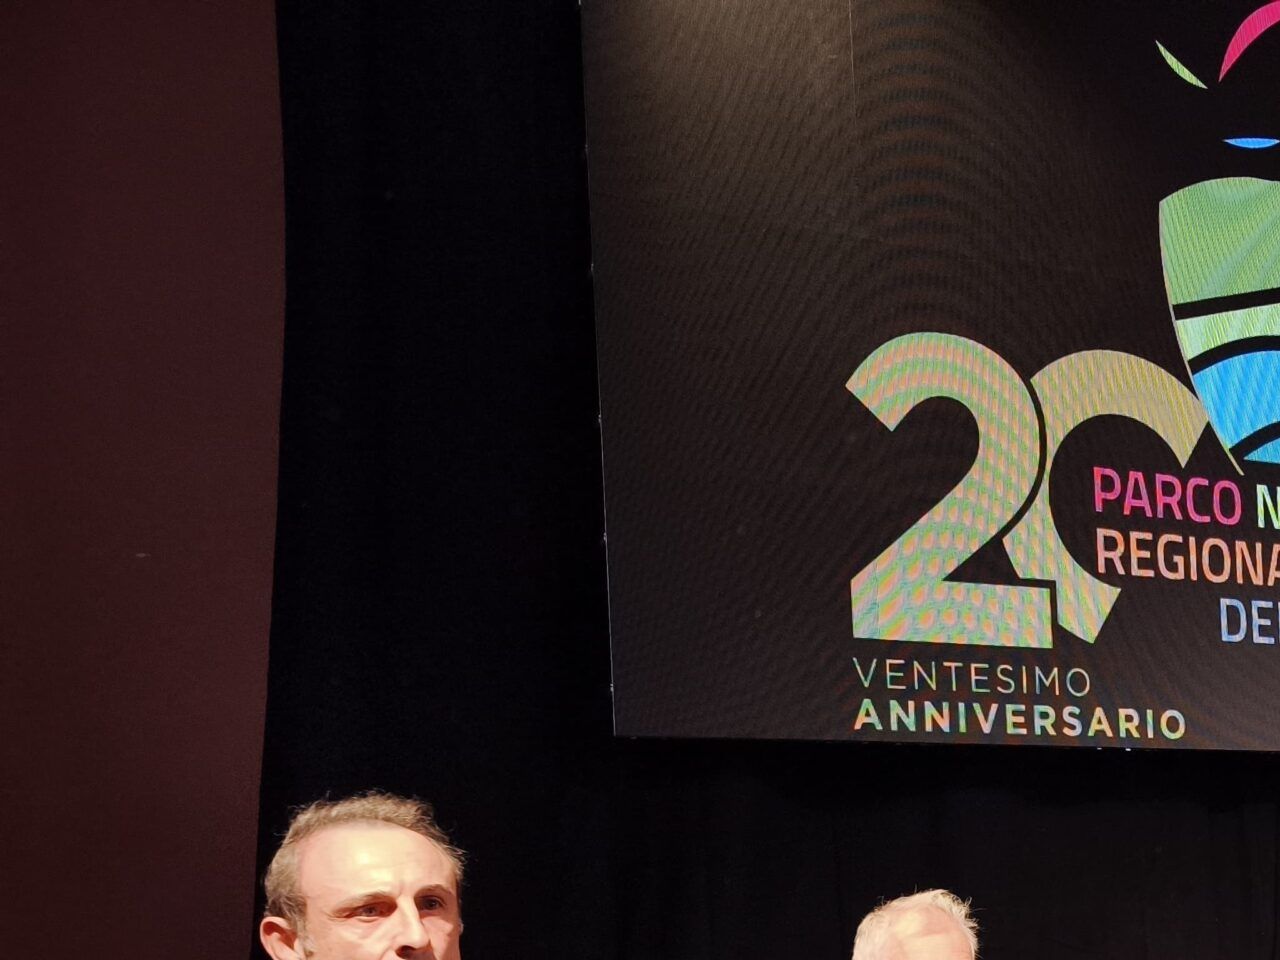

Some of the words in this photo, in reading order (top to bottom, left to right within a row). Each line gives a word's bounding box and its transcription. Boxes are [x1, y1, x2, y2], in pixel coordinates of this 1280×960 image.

[1093, 467, 1243, 526] PARCO
[853, 657, 1091, 697] VENTESIMO
[854, 699, 1187, 741] ANNIVERSARIO
